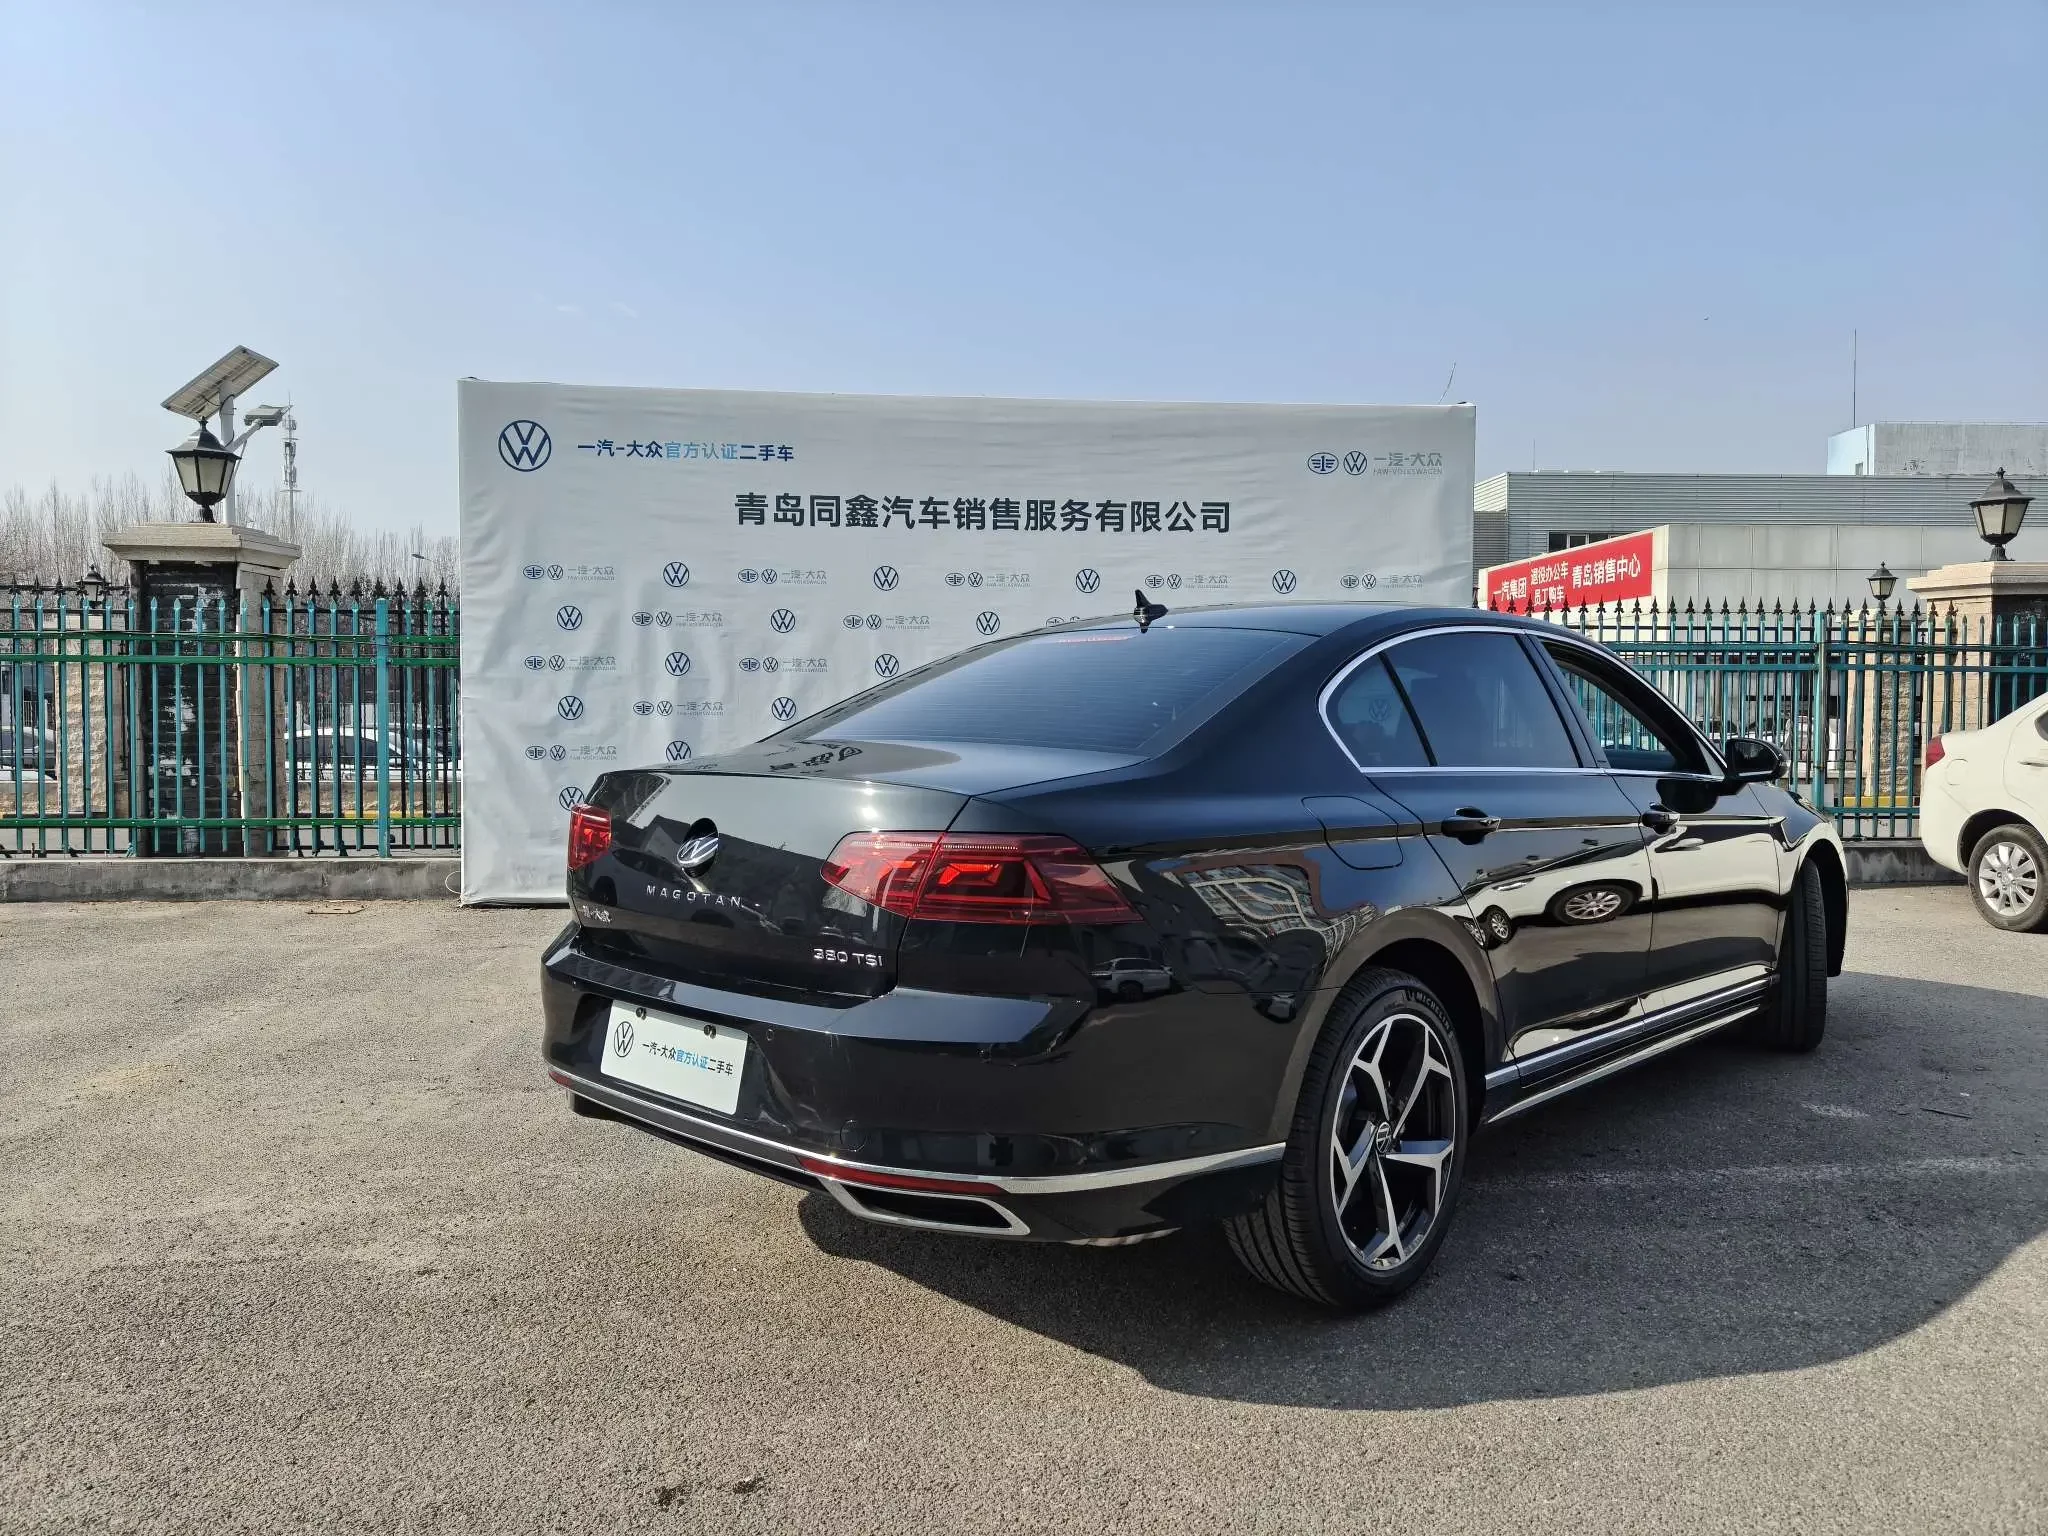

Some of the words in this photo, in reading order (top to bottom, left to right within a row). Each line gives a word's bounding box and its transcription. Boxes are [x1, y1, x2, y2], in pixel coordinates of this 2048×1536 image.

[498, 420, 551, 472] VW
[577, 439, 795, 462] 一汽-大众官方认证二手车
[1373, 452, 1443, 467] 一汽-大众
[733, 492, 1231, 534] 青岛同鑫汽车销售服务有限公司
[663, 561, 690, 587] VW
[873, 565, 899, 591] VW
[1075, 568, 1100, 593] VW
[1272, 569, 1297, 594] VW
[1572, 552, 1641, 590] 青岛销售中心
[1493, 576, 1527, 602] 一汽集团
[1533, 584, 1565, 607] 员工购车
[556, 605, 583, 631] VW
[770, 608, 796, 633] VW
[976, 611, 1001, 635] VW
[664, 651, 691, 677] VW
[557, 695, 584, 721] VW
[771, 696, 797, 721] VW
[646, 884, 741, 908] MAGOTAN
[813, 948, 848, 963] 380
[851, 952, 882, 967] TSI
[1416, 991, 1450, 1030] MICHELIN
[613, 1020, 635, 1058] VW
[641, 1041, 734, 1077] 一汽-大众官方认证二手车
